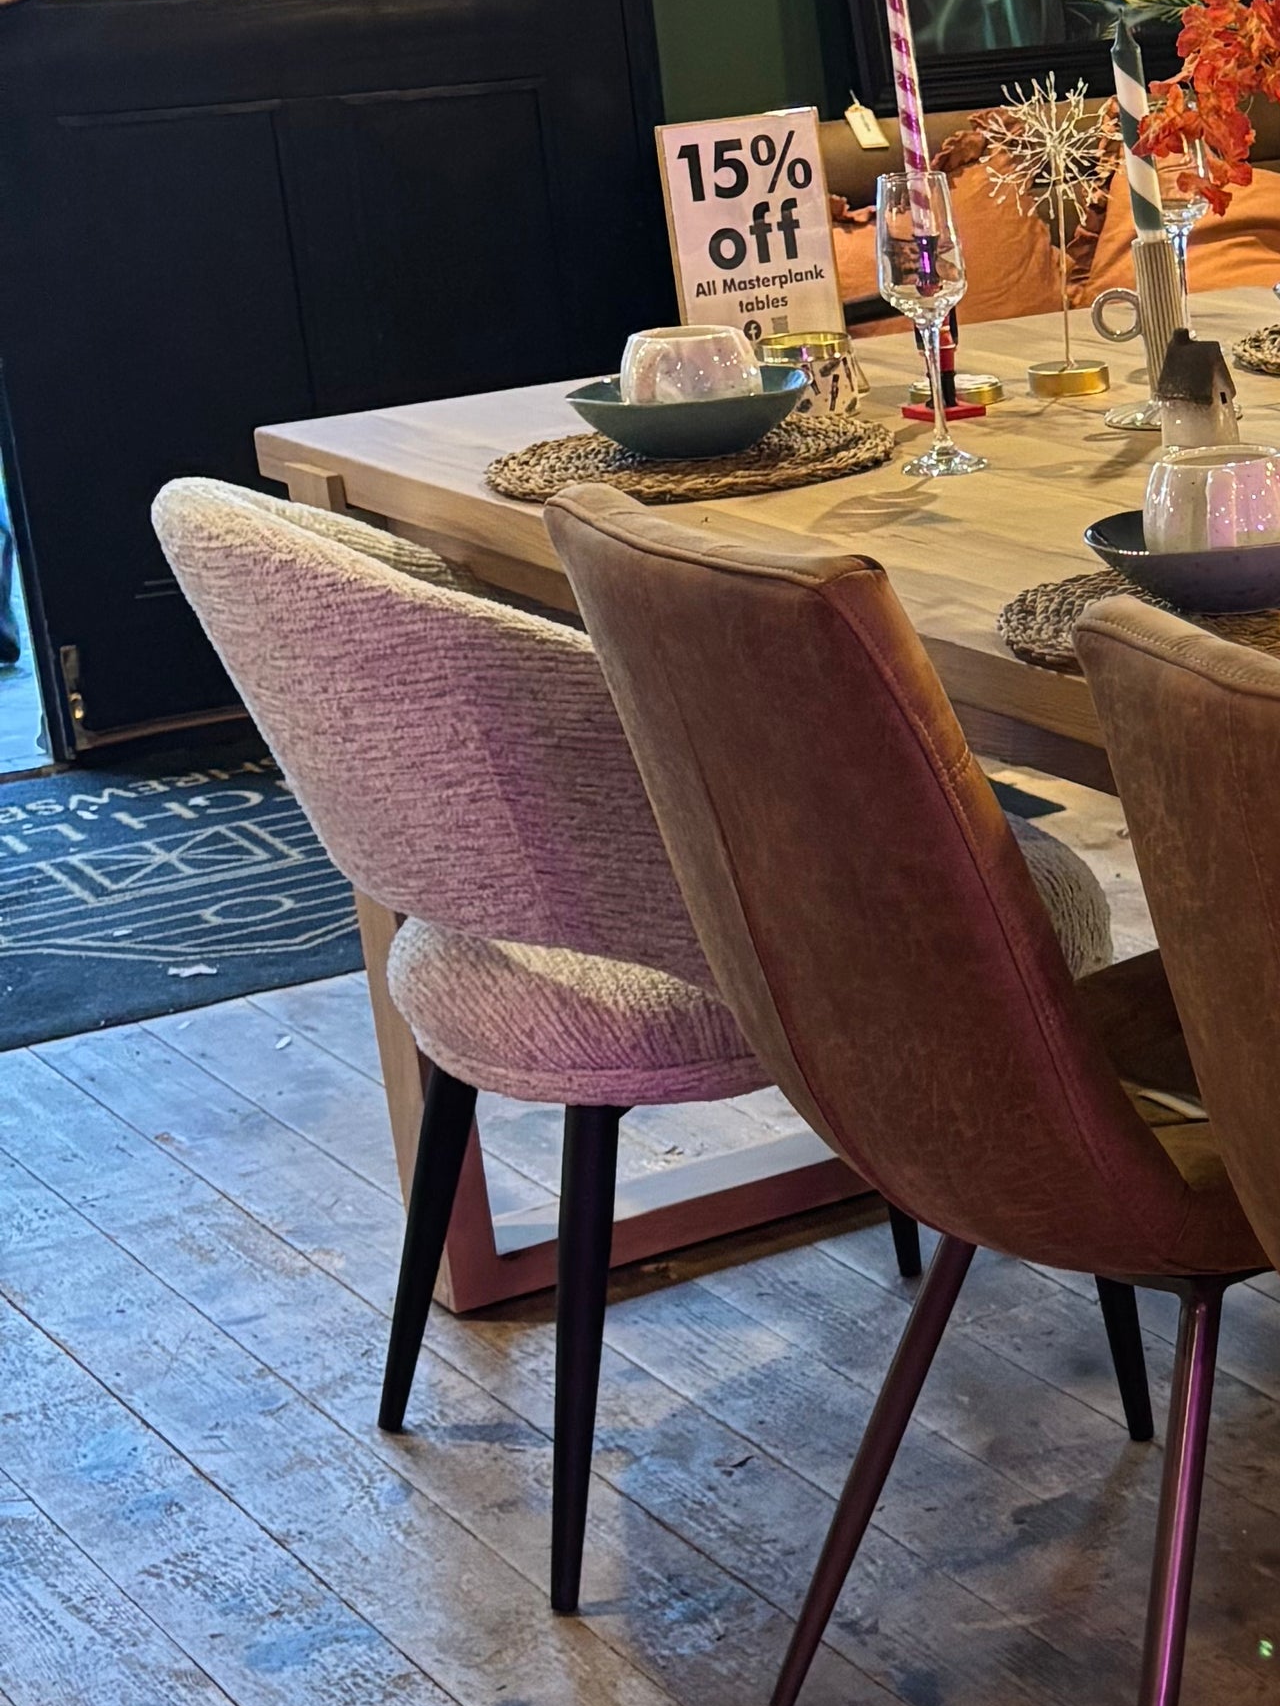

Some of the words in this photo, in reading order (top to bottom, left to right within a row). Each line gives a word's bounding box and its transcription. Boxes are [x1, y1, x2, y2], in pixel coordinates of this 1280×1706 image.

[676, 130, 813, 202] 15%
[708, 197, 801, 271] off
[695, 279, 717, 298] All
[722, 264, 826, 295] Masterplank
[738, 294, 789, 314] tables
